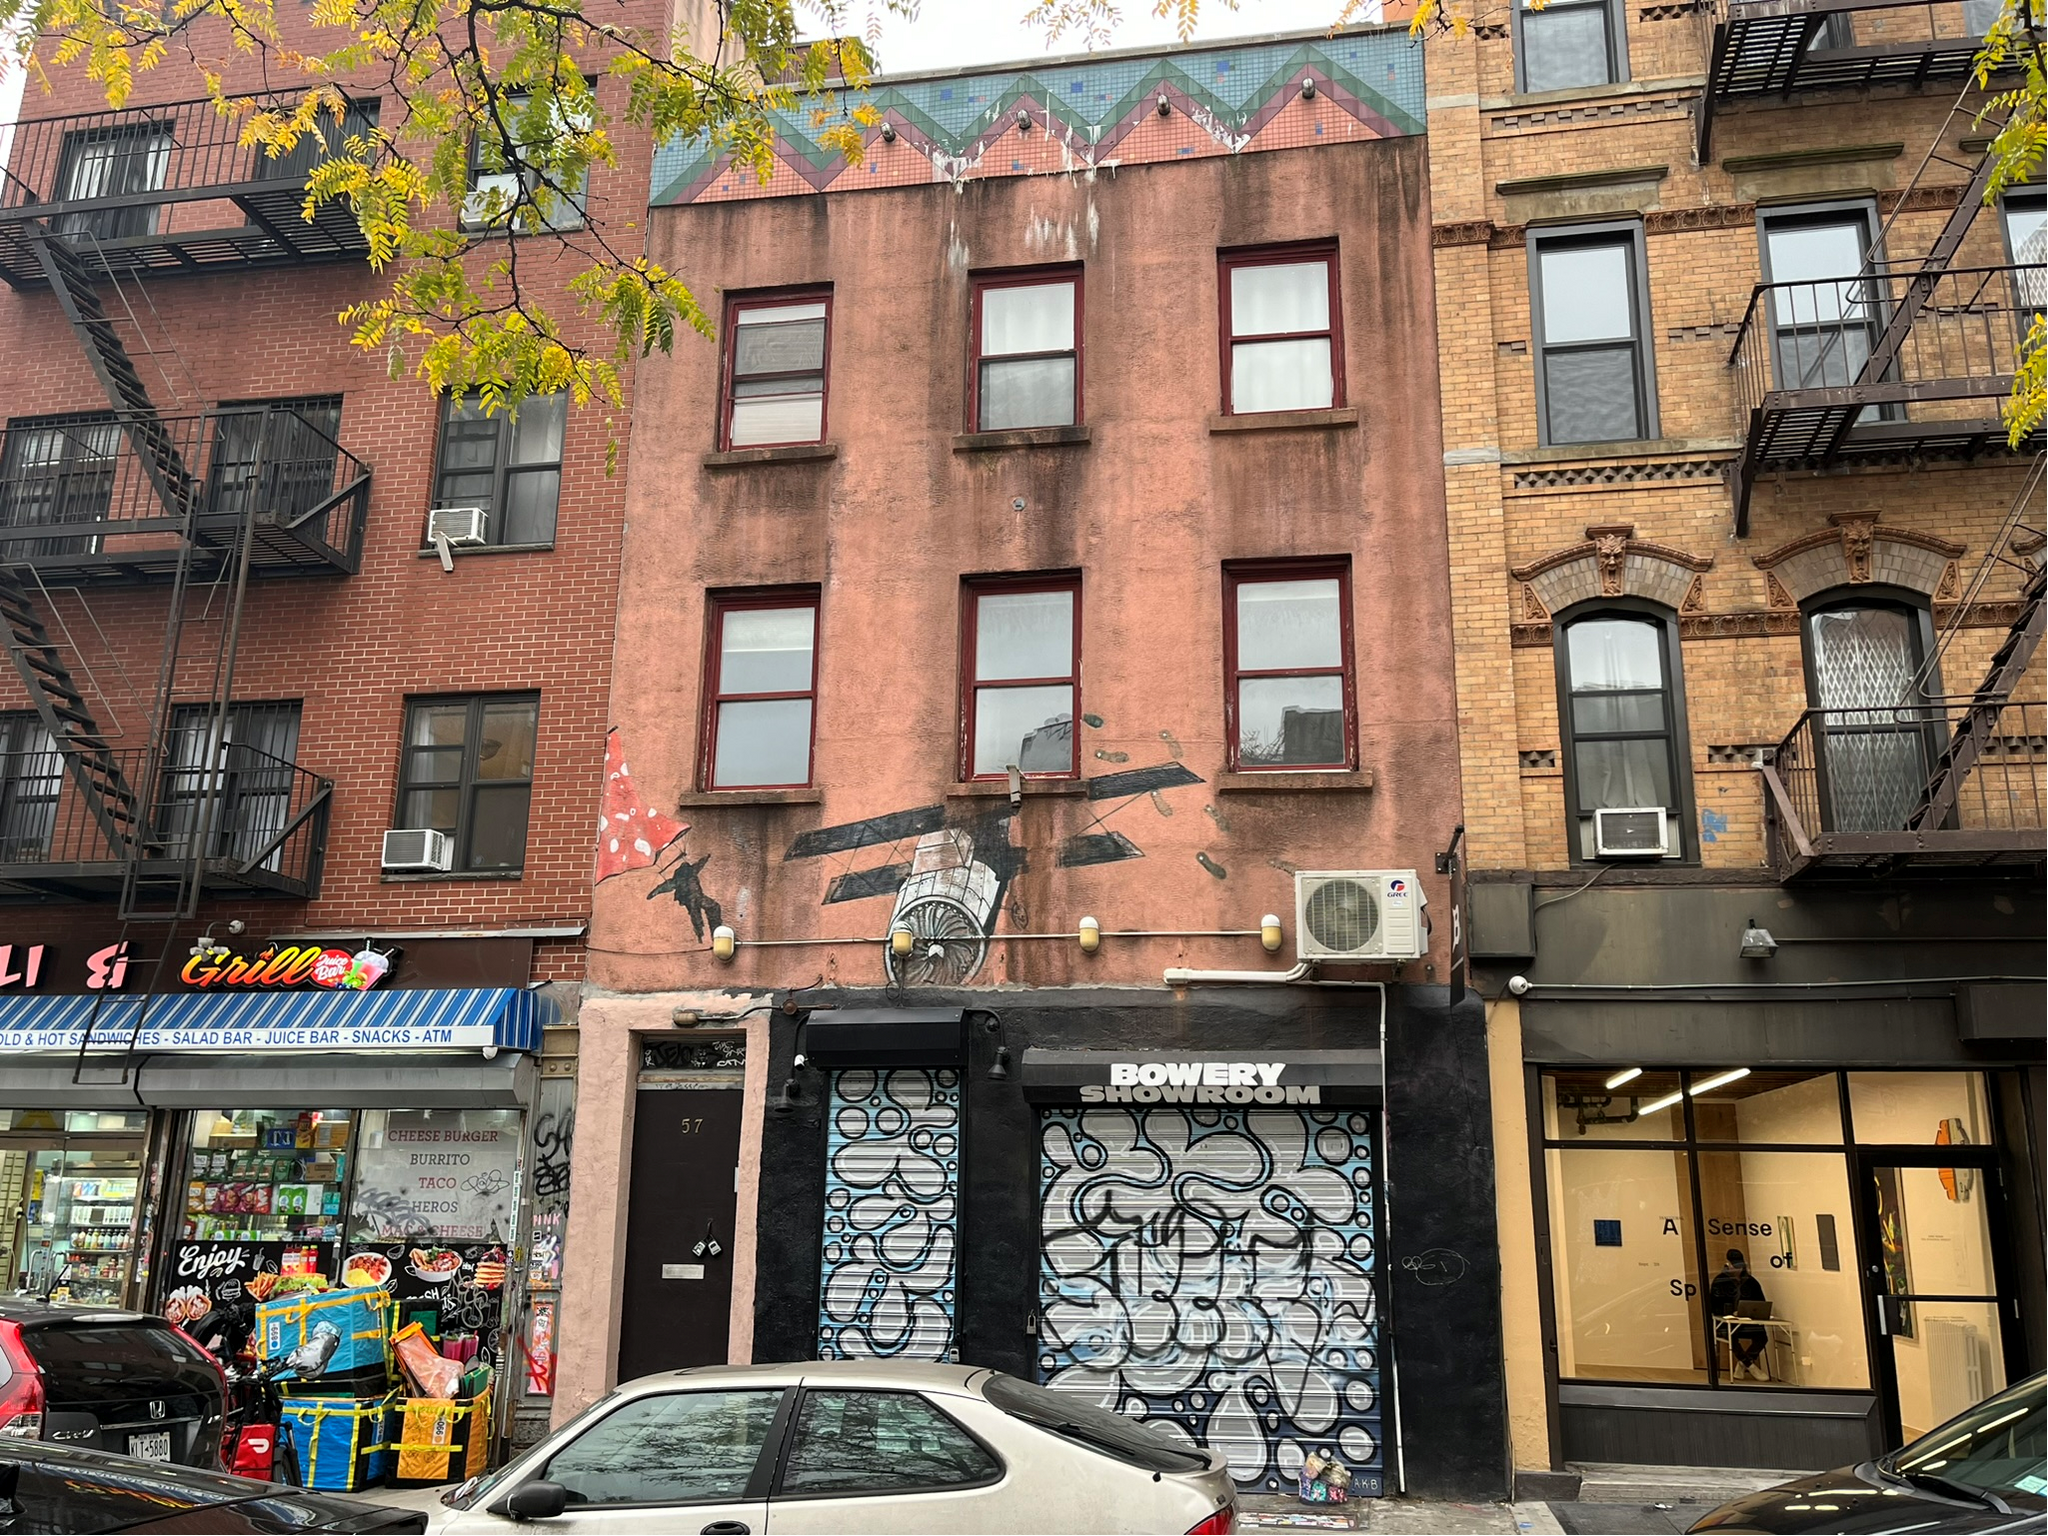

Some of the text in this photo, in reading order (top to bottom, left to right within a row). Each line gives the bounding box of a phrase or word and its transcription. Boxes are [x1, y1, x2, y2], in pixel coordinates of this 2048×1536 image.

[180, 946, 322, 988] Grill
[315, 953, 348, 967] Juice
[315, 965, 345, 982] Bar
[25, 1034, 33, 1046] &
[38, 1033, 66, 1045] HOT
[69, 1032, 160, 1046] SANDWICHES
[172, 1032, 220, 1045] SALAD
[223, 1032, 253, 1045] BAR
[264, 1031, 305, 1044] JUICE
[309, 1030, 339, 1044] BAR
[352, 1030, 411, 1043] SNACKS
[422, 1030, 452, 1043] ATM
[1110, 1062, 1286, 1087] BOWERY
[1079, 1085, 1321, 1105] SHOWROOM
[681, 1118, 703, 1134] 57
[388, 1130, 498, 1143] CHEESE BURGER
[410, 1153, 470, 1166] BURRITO
[418, 1177, 457, 1189] TACO
[411, 1201, 458, 1214] HEROS
[431, 1225, 485, 1238] CHEESE
[1662, 1218, 1772, 1236] A Sense
[177, 1244, 246, 1279] Enjoy
[1770, 1252, 1793, 1269] of
